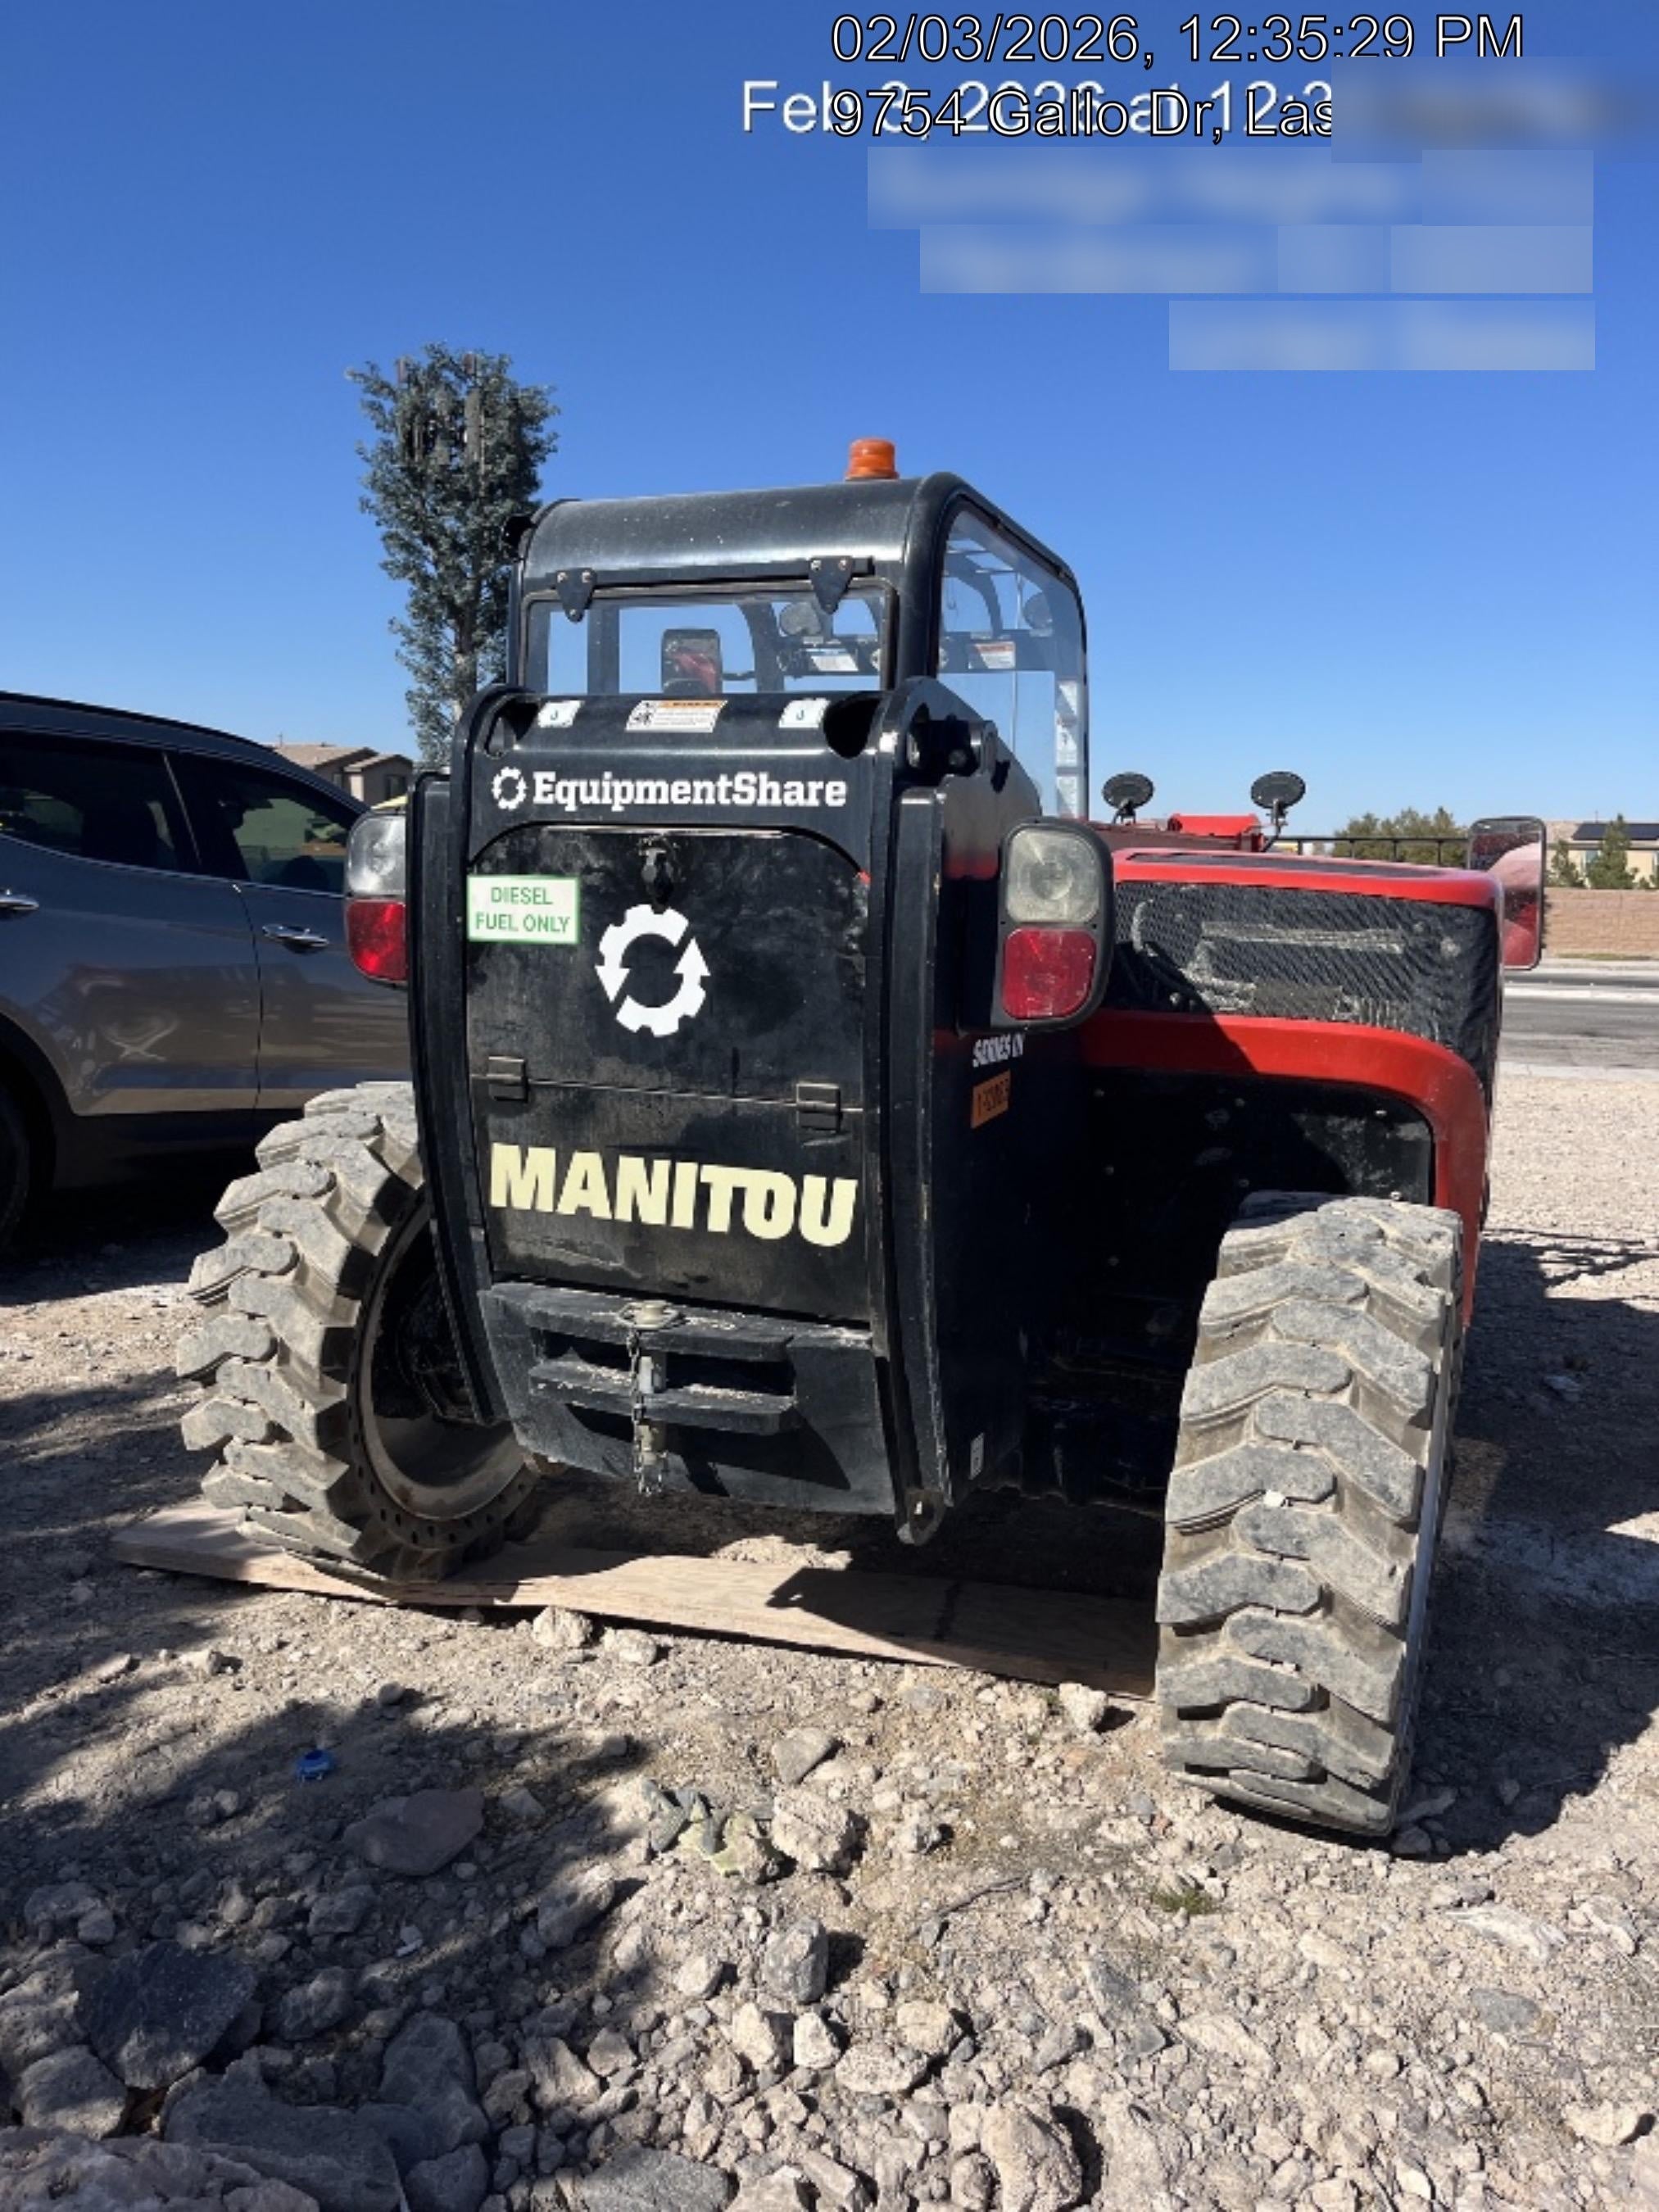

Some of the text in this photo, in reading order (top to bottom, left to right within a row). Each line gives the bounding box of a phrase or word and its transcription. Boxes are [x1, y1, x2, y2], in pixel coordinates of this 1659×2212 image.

[533, 771, 847, 811] EquipmentShare
[490, 886, 554, 905] DIESEL
[475, 911, 572, 933] FUEL ONLY
[490, 1142, 859, 1248] MANITOU
